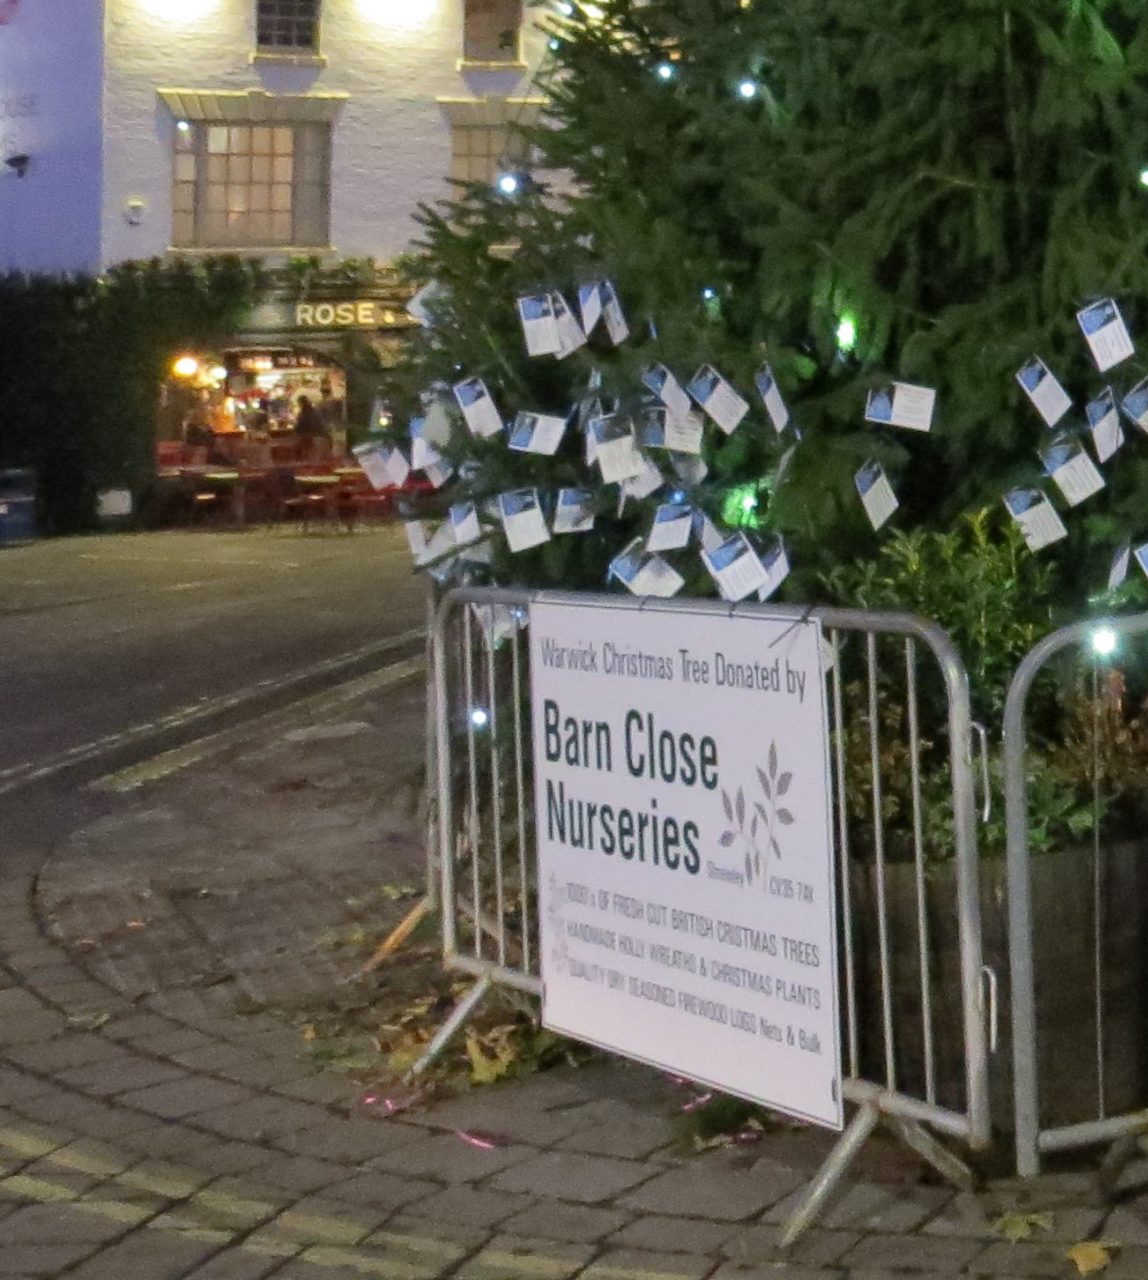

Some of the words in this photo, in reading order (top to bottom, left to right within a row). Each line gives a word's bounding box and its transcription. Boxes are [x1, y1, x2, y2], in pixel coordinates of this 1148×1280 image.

[296, 302, 375, 326] ROSE
[541, 640, 597, 672] Warwick
[603, 642, 673, 679] Christmas
[679, 649, 709, 684] Tree
[715, 652, 779, 693] Donated
[786, 659, 806, 704] by
[544, 698, 612, 772] Barn
[625, 709, 718, 790] Close
[546, 778, 700, 875] Nurseries
[567, 920, 616, 951] HANDMADE
[618, 934, 644, 959] HOLLY
[648, 942, 696, 975] WREATHS
[699, 956, 707, 978] &
[711, 960, 773, 997] CHRISTMAS
[775, 977, 821, 1011] PLANTS
[598, 888, 609, 911] OF
[613, 892, 644, 919] FRESH
[647, 901, 667, 926] CUT
[671, 908, 713, 939] BRITISH
[781, 936, 820, 968] TREES
[628, 975, 677, 1008] SEASONED
[678, 991, 728, 1025] FIREWOOD
[730, 1008, 757, 1035] LOGS
[760, 1016, 782, 1043] Nets
[786, 1023, 795, 1047] &
[798, 1028, 822, 1055] Bulk
